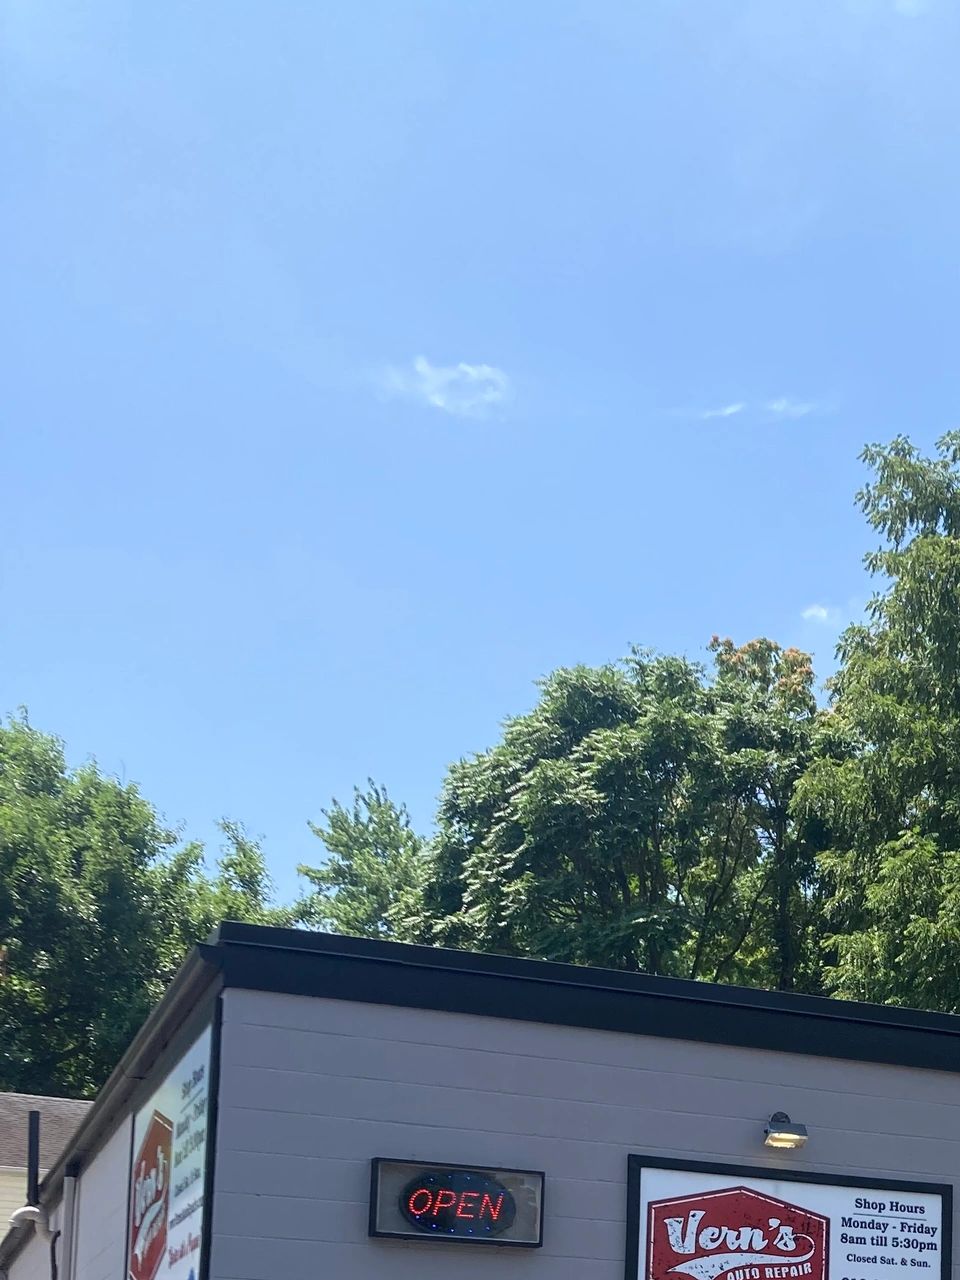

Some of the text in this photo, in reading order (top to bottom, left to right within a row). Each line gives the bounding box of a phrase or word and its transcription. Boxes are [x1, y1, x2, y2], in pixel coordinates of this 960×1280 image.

[408, 1188, 504, 1221] OPEN
[854, 1198, 926, 1215] Shop Hours
[663, 1210, 798, 1253] Vern's
[841, 1216, 889, 1233] Monday
[900, 1221, 938, 1238] Friday
[840, 1232, 938, 1253] 8am till 5:30pm
[765, 1262, 812, 1280] REPAIR
[846, 1253, 931, 1269] Closed Sat. & Sun.
